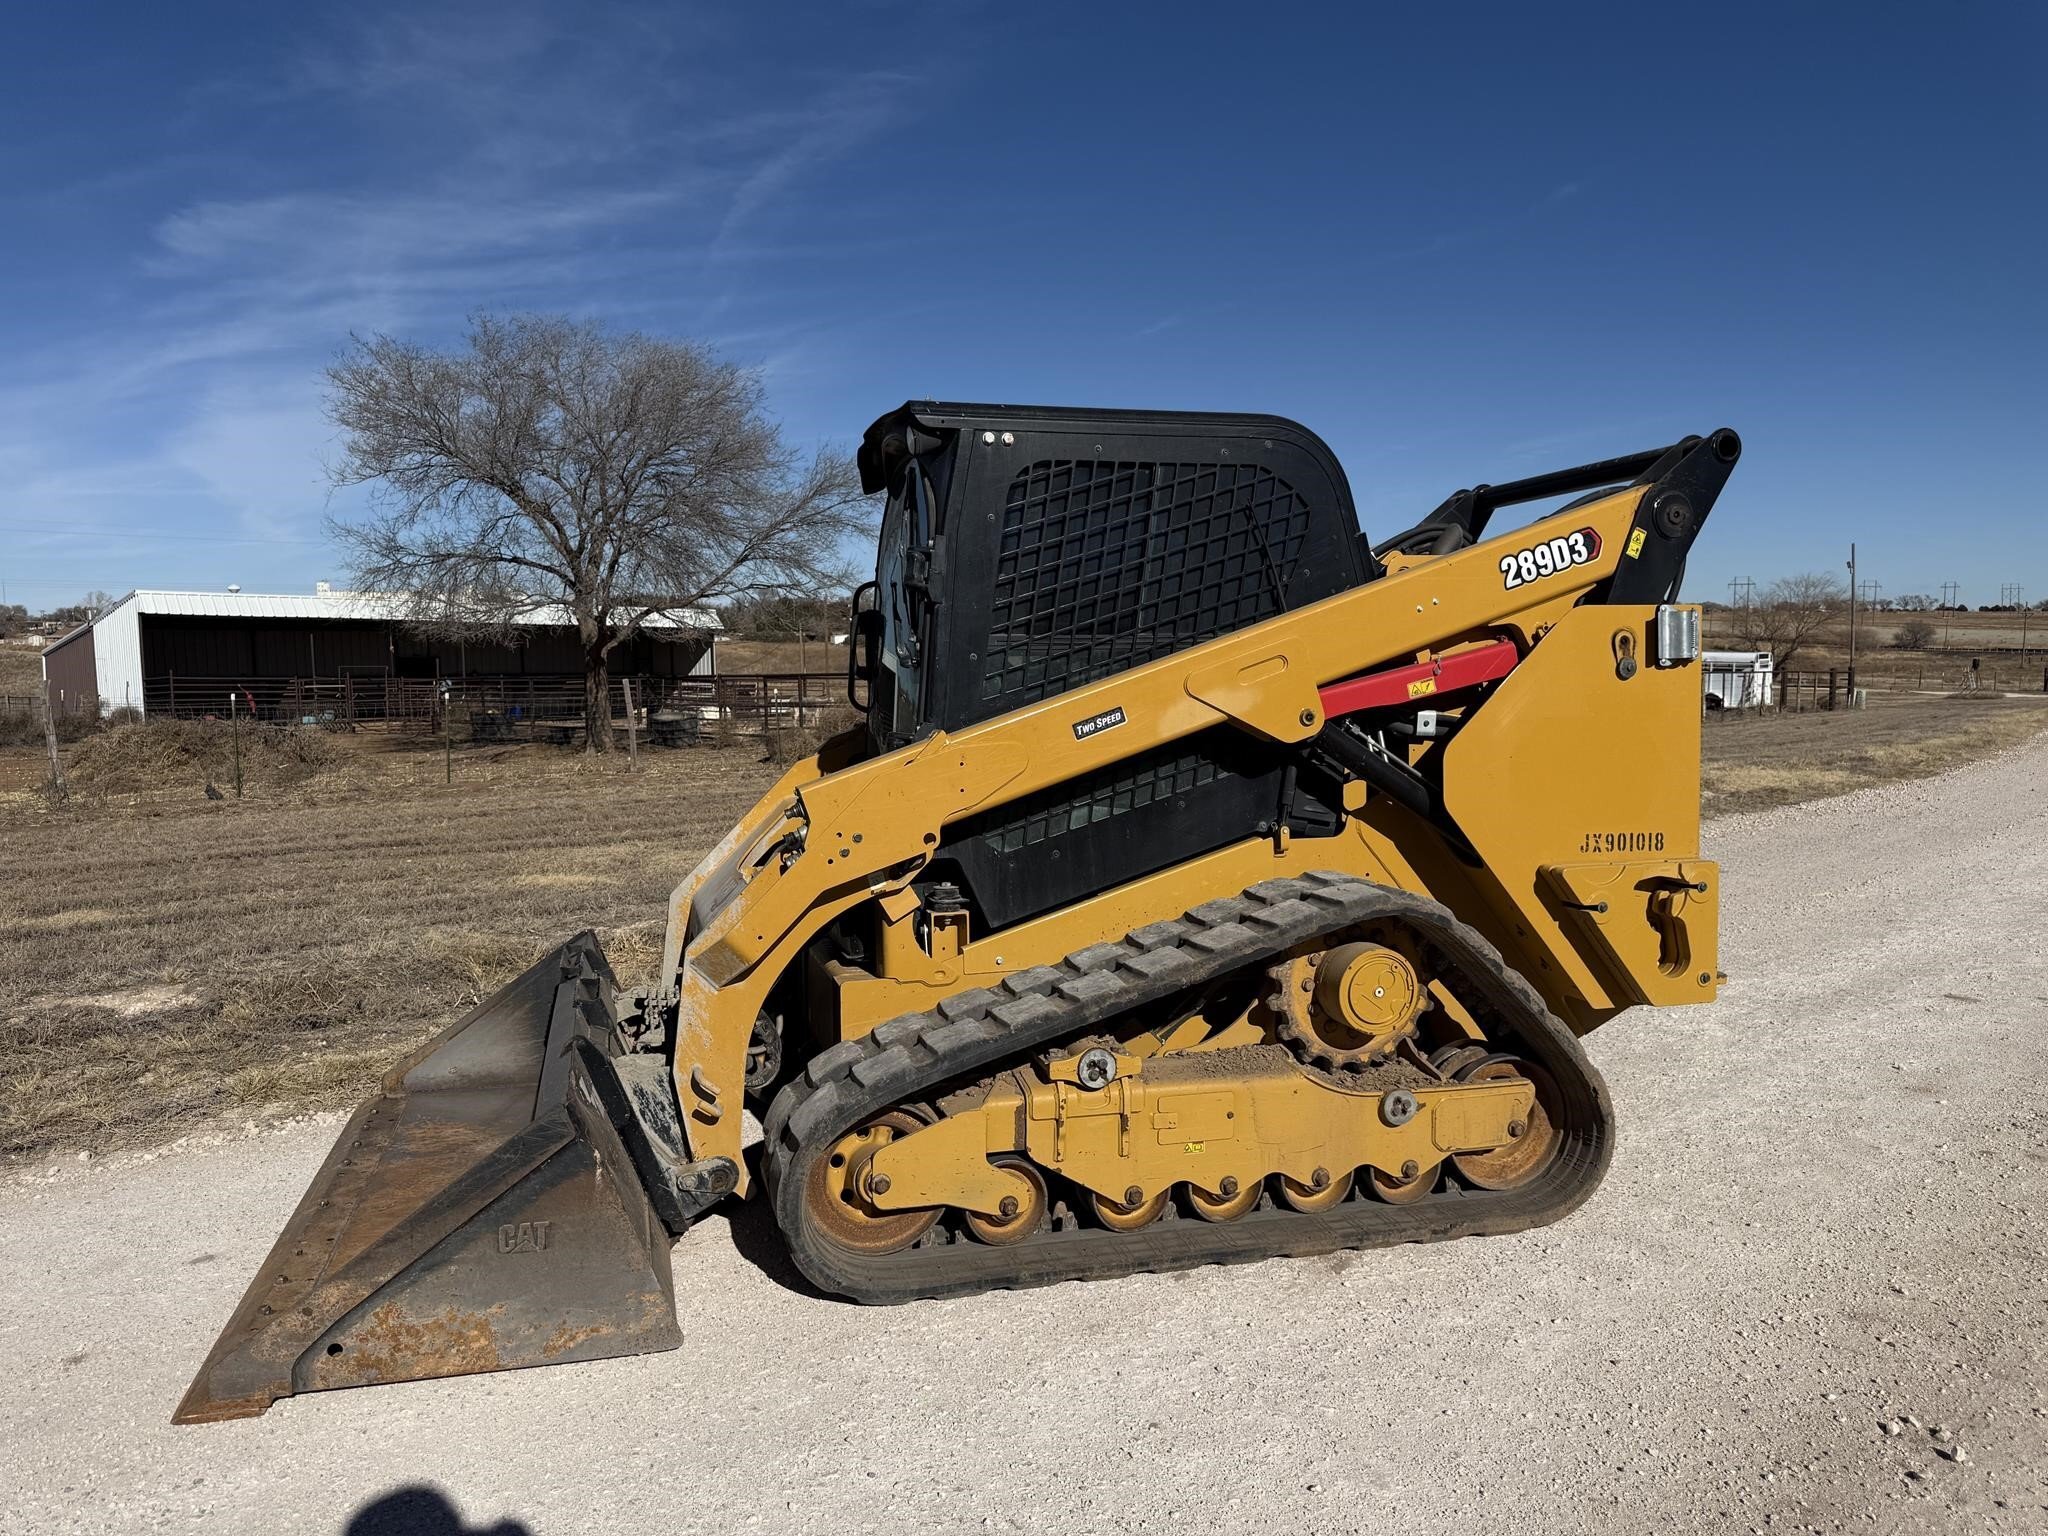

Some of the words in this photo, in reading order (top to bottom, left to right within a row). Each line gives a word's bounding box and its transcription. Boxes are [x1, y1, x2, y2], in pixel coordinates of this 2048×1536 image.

[1500, 531, 1589, 589] 289D3
[1076, 722, 1095, 735] TWO
[1096, 712, 1121, 728] SPEED
[1580, 832, 1664, 853] JX901018
[499, 1221, 551, 1254] CAT
